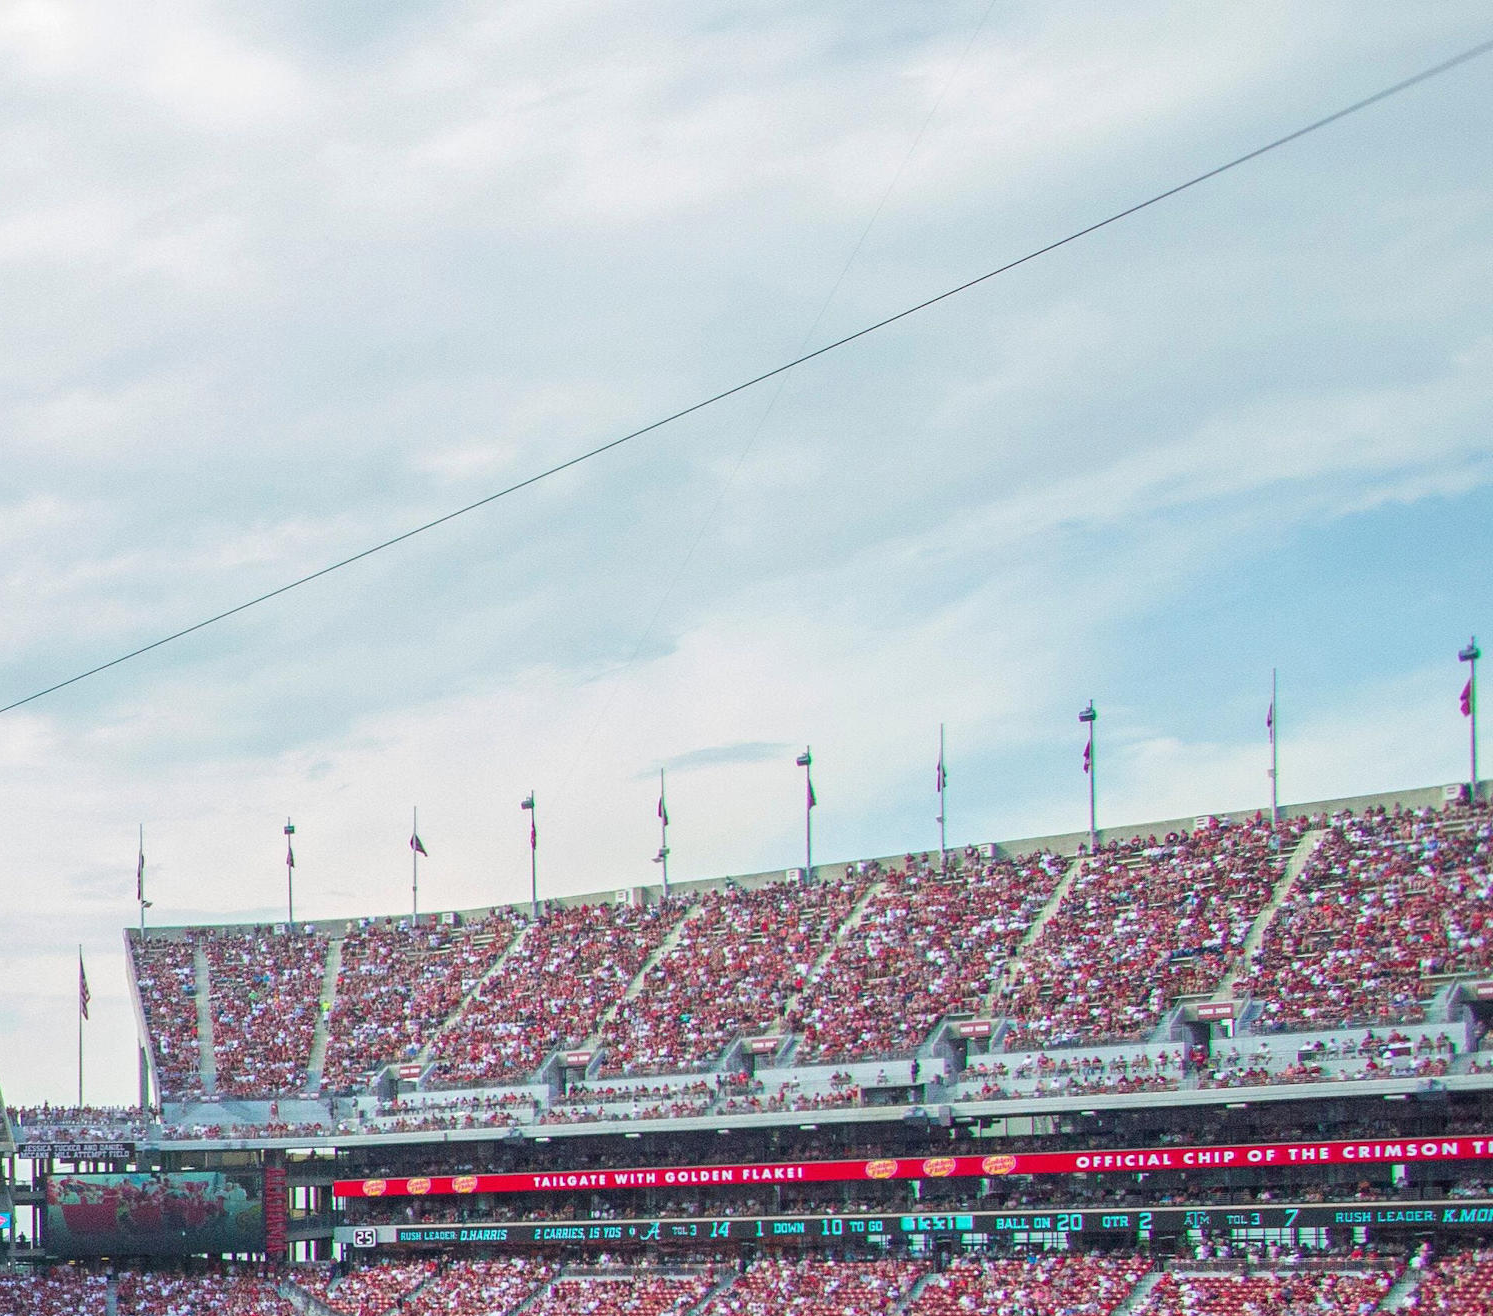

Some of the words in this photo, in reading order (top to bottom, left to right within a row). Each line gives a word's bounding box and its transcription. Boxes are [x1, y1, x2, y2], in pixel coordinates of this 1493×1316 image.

[1076, 1153, 1172, 1168] OFFICIAL
[1183, 1151, 1235, 1164] CHIP
[1247, 1149, 1275, 1162] OF
[1288, 1147, 1329, 1160] THE
[1342, 1142, 1457, 1159] CRIMSON
[533, 1174, 606, 1187] TAILGATE
[614, 1172, 656, 1184] WITH
[665, 1170, 733, 1182] GOLDEN
[742, 1167, 803, 1180] FLAKE!
[996, 1217, 1029, 1229] BALL
[1033, 1217, 1051, 1229] ON
[1056, 1214, 1083, 1232] 20
[1102, 1216, 1129, 1228] QTR
[1139, 1212, 1153, 1230] 2
[1250, 1213, 1261, 1226] 3
[1284, 1209, 1299, 1227] 7
[1335, 1211, 1371, 1222] RUSH
[1377, 1210, 1437, 1222] LEADER:
[401, 1231, 422, 1241] RUSH
[424, 1231, 458, 1240] LEADER:
[460, 1229, 508, 1241] D.HARRIS
[534, 1228, 541, 1240] 2
[544, 1228, 585, 1240] CARRIES,
[589, 1227, 600, 1239] 15
[604, 1227, 622, 1239] YDS
[690, 1225, 697, 1236] 3
[710, 1221, 730, 1238] 14
[756, 1220, 764, 1237] 1
[773, 1222, 805, 1233] DOWN
[821, 1219, 843, 1235] 10
[849, 1221, 864, 1232] TO
[868, 1220, 883, 1231] GO
[356, 1231, 373, 1245] 25
